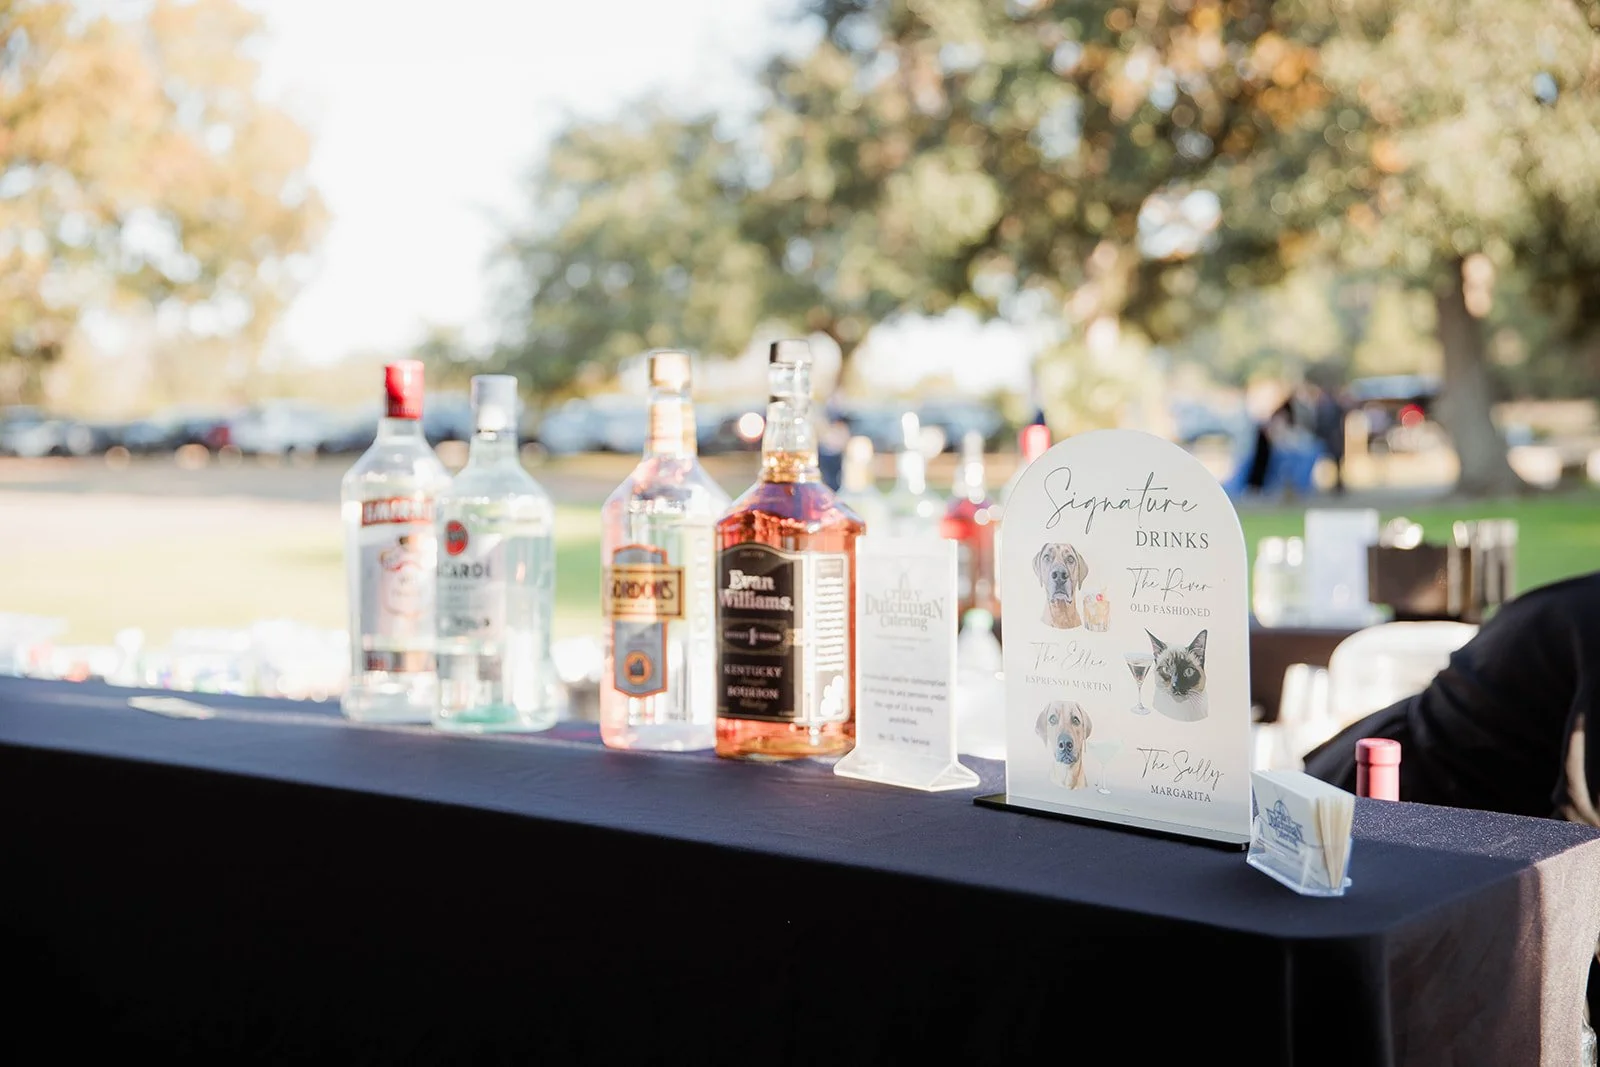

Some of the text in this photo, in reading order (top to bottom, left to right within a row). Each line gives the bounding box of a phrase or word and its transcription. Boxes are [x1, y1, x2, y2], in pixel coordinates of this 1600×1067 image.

[1043, 466, 1199, 535] Signature
[1136, 530, 1209, 549] DRINKS
[729, 569, 775, 591] Evan
[1126, 567, 1213, 602] The River
[1130, 603, 1212, 617] OLD FASHIONED
[1029, 640, 1059, 672] The
[723, 664, 783, 678] KENTUCKY
[727, 685, 779, 700] BOURBON
[1025, 675, 1113, 693] ESPRESSO MARTINI
[1136, 747, 1225, 791] The Sully
[1150, 784, 1212, 803] MARGARITA
